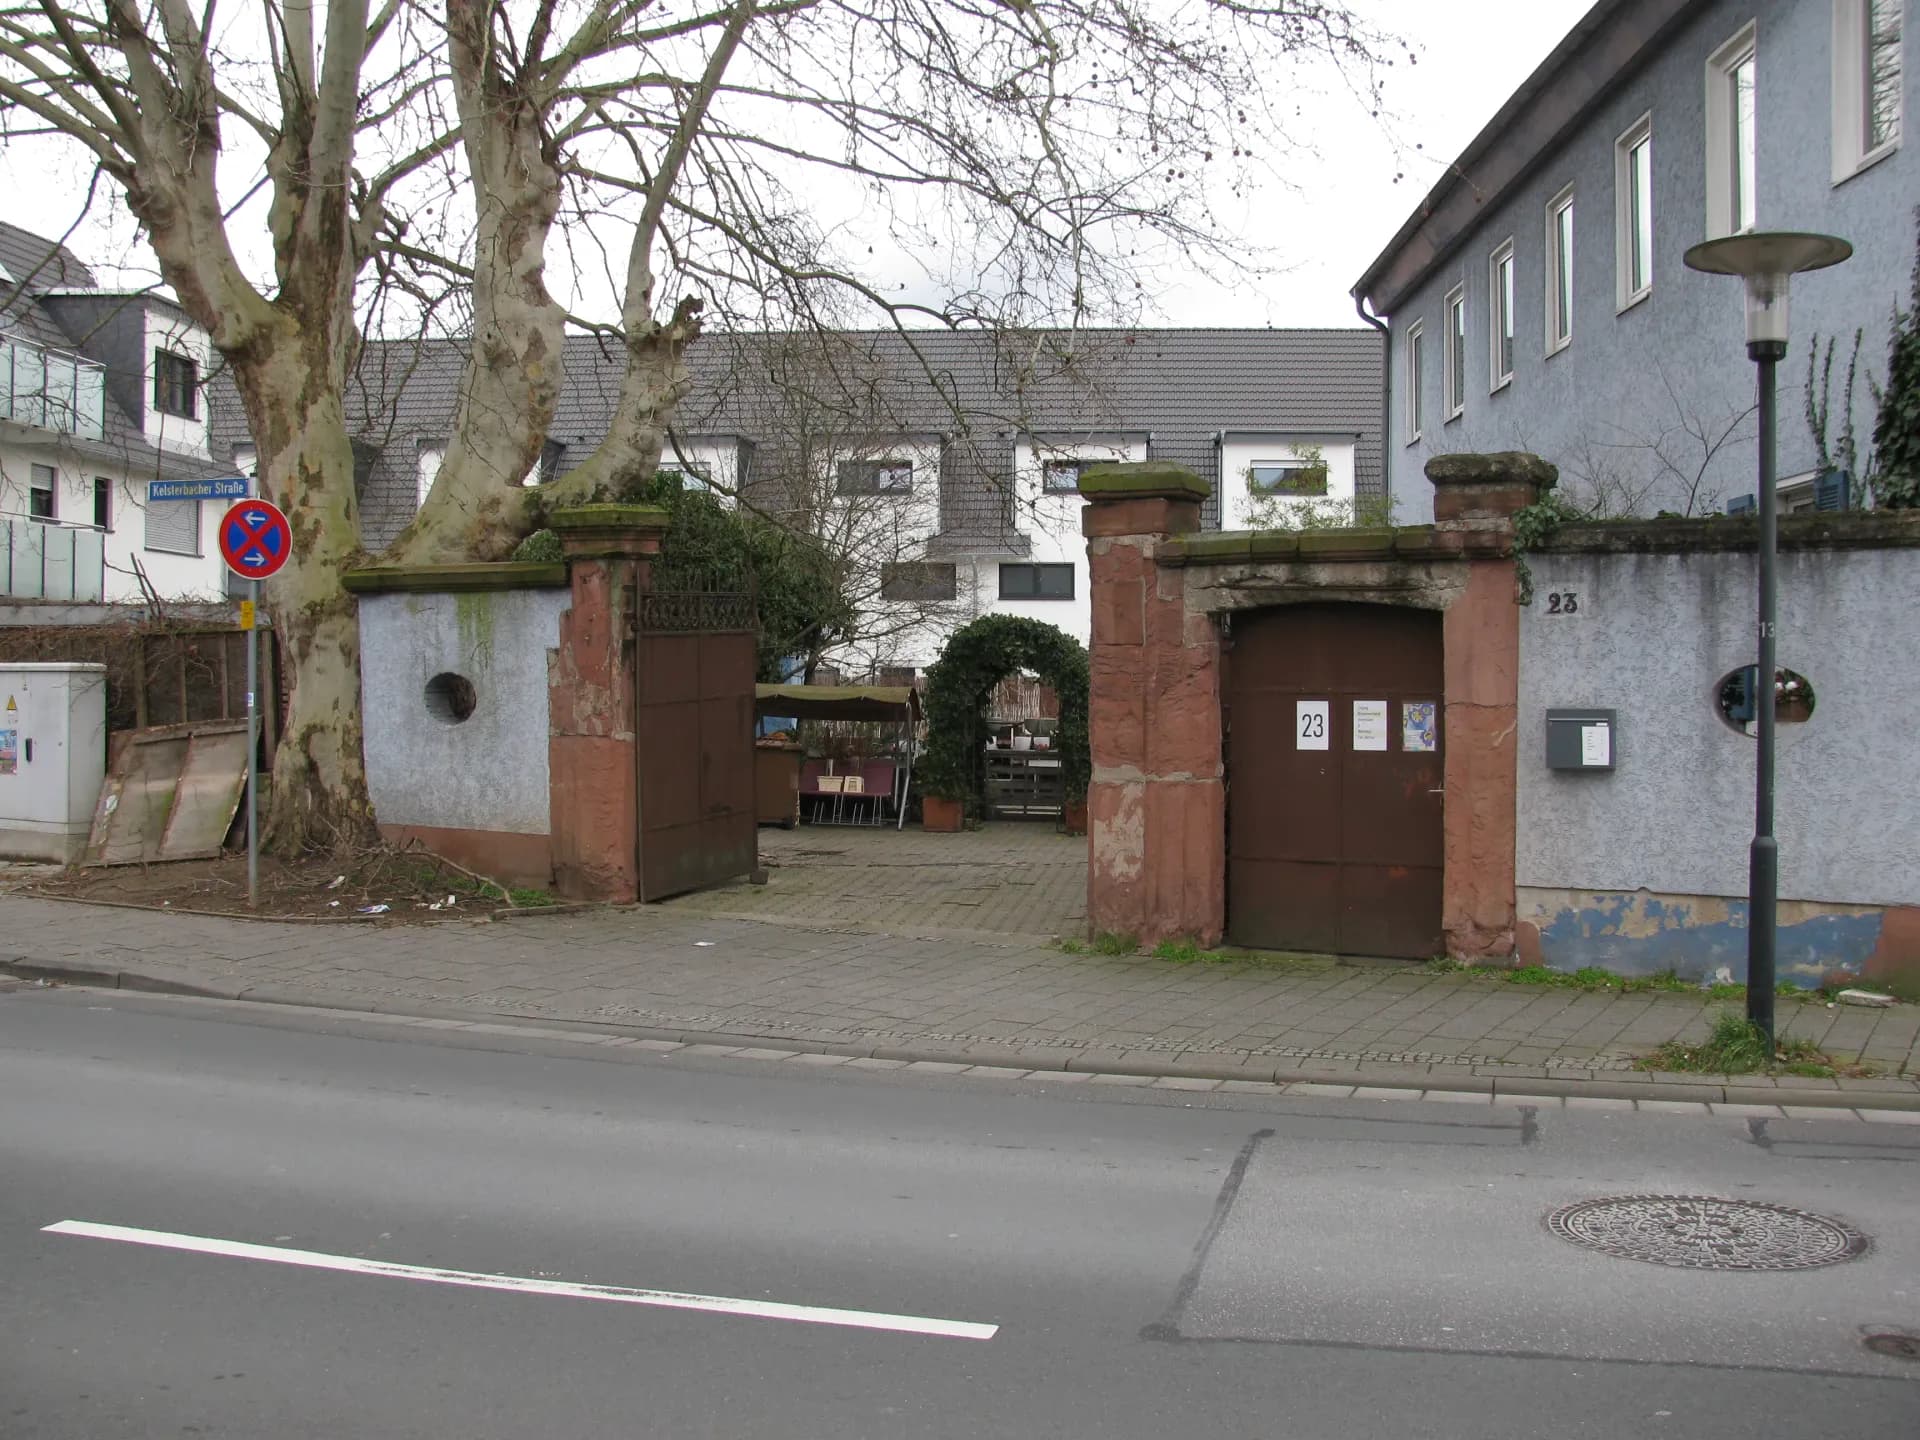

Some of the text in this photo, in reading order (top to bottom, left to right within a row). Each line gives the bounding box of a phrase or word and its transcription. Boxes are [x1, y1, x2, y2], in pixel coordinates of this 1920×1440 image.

[153, 481, 244, 497] Kelsterbacher Straße
[1547, 592, 1578, 614] 23
[1760, 621, 1775, 638] 13
[1302, 713, 1324, 738] 23
